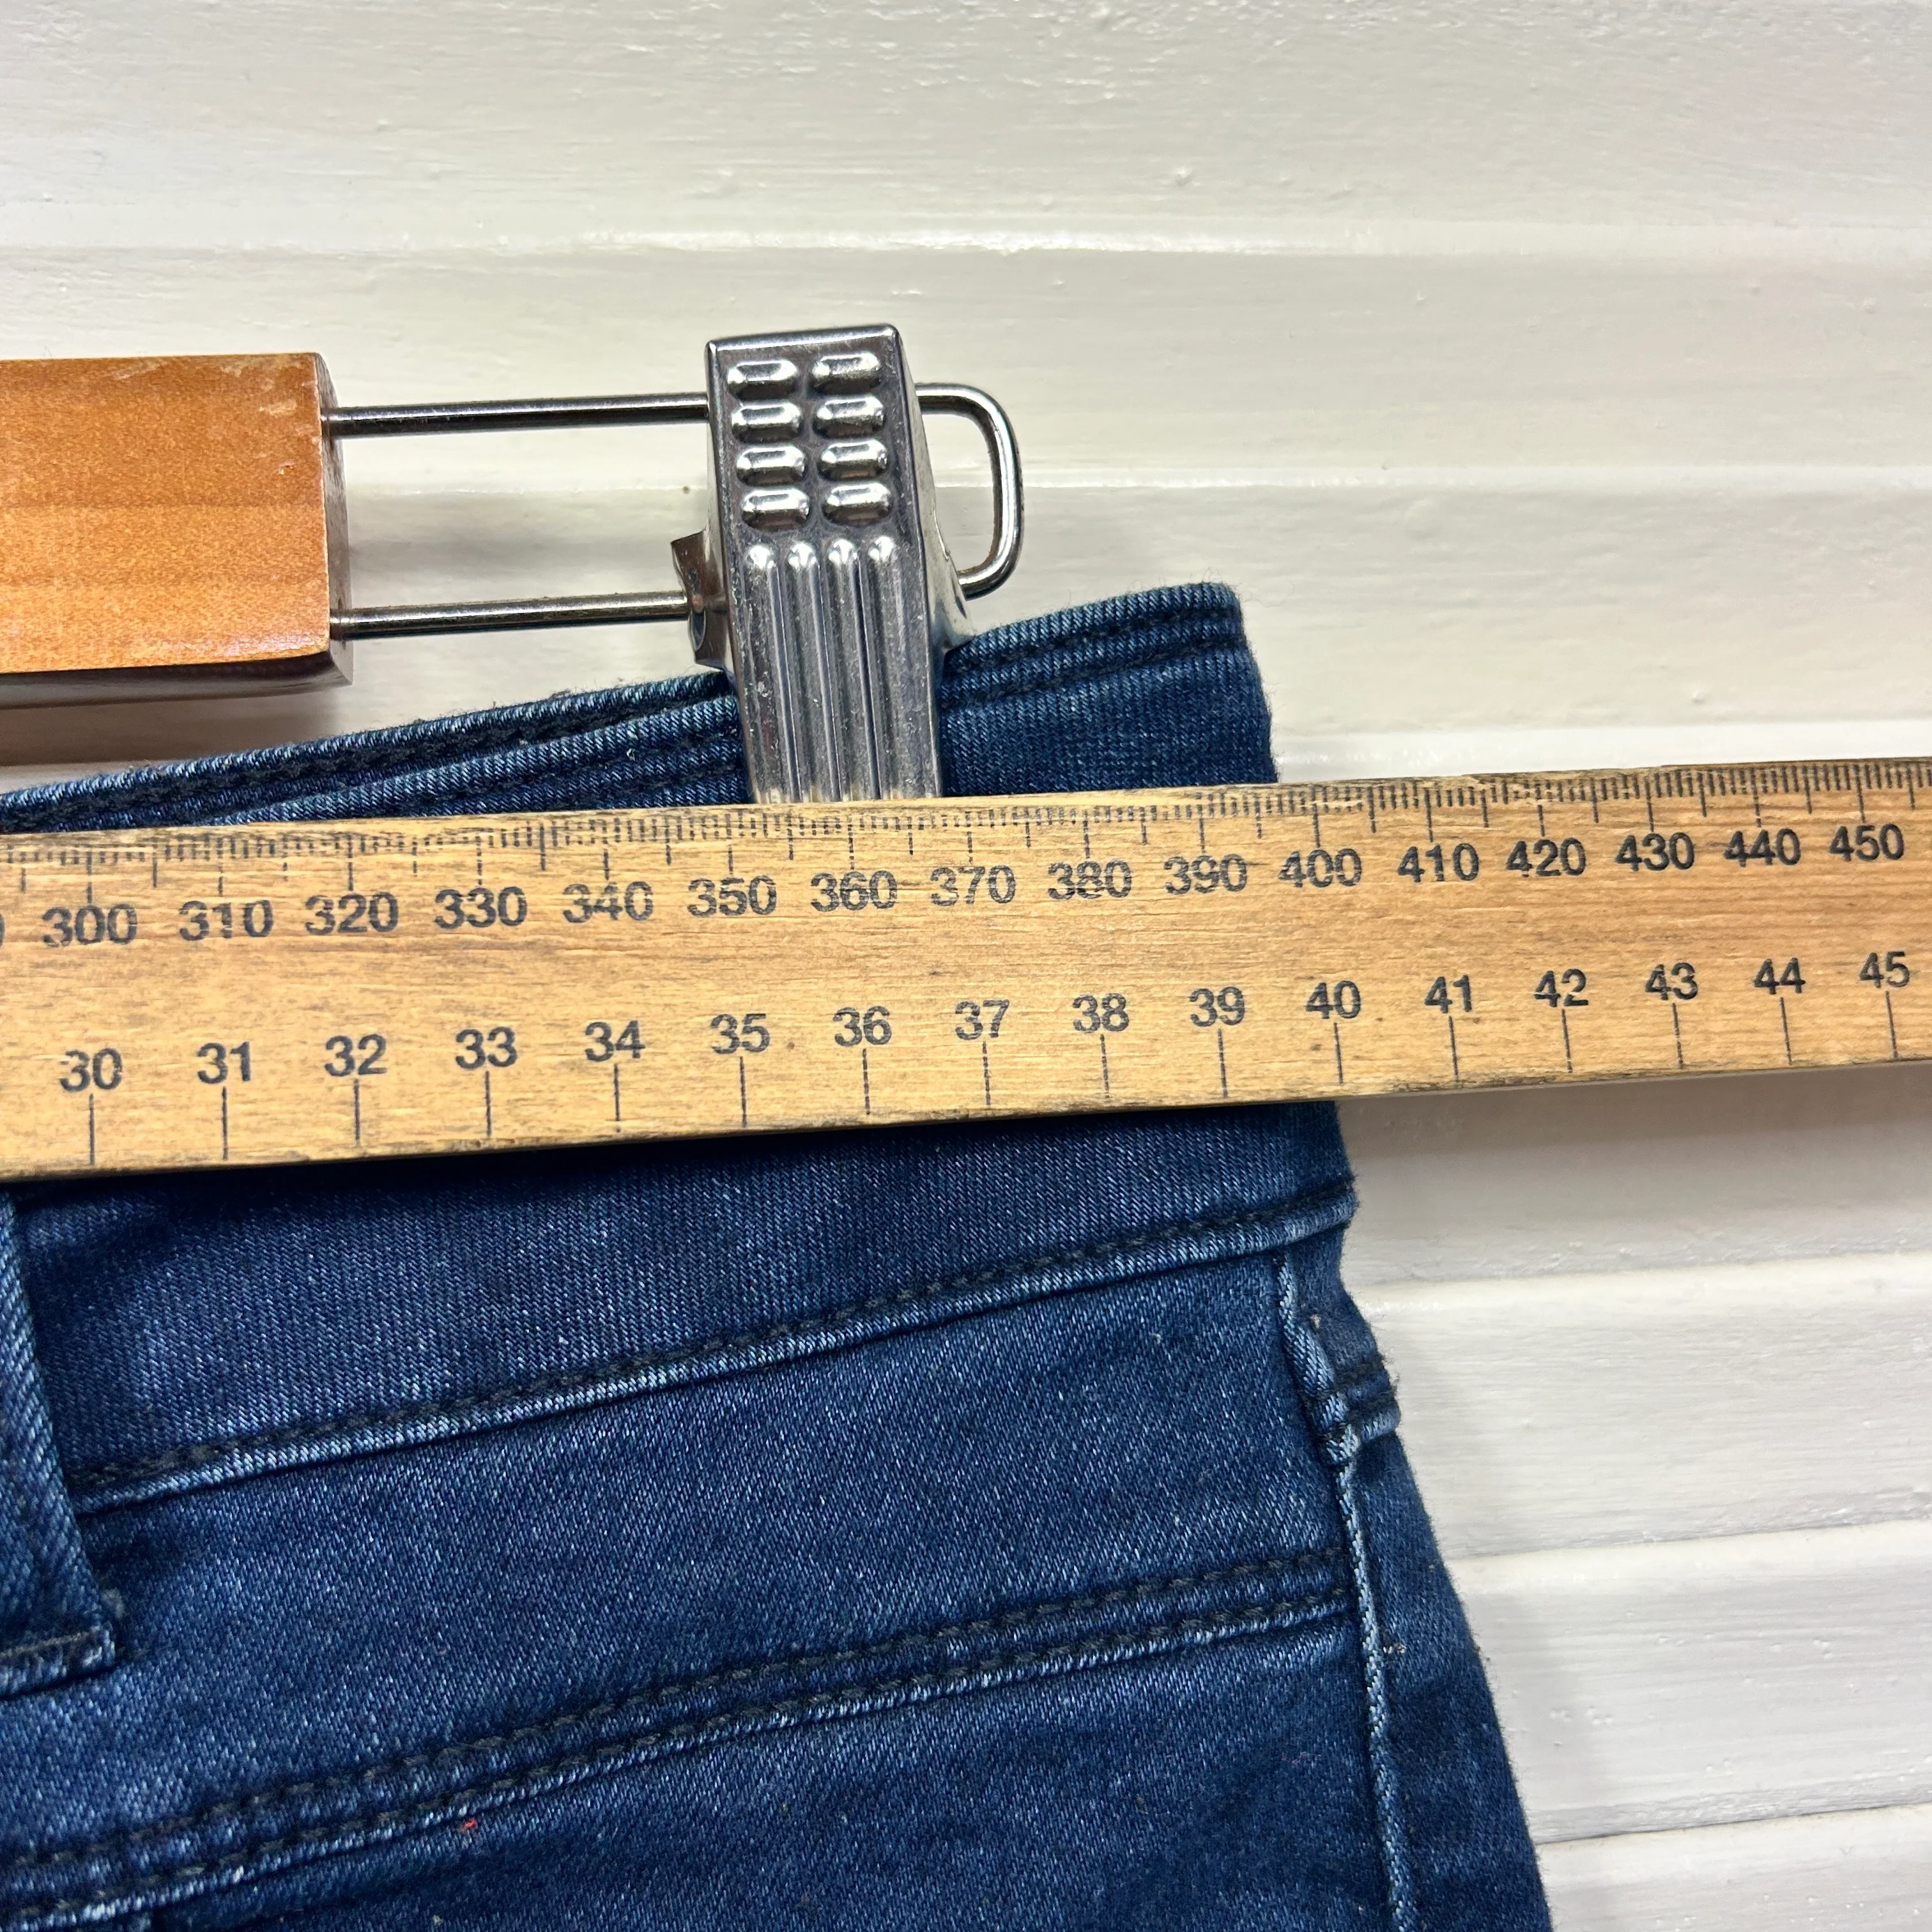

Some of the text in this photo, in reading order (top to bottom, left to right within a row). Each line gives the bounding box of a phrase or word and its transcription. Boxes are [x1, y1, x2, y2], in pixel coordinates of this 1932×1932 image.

[42, 905, 138, 947] 300
[179, 900, 273, 940] 310
[305, 892, 399, 935] 320
[434, 887, 528, 929] 330
[562, 881, 654, 923] 340
[687, 875, 777, 917] 350
[810, 870, 897, 912] 360
[930, 865, 1016, 907] 370
[1048, 860, 1132, 900] 380
[1164, 854, 1247, 894] 390
[1280, 848, 1362, 887] 400
[1396, 843, 1481, 883] 410
[1505, 838, 1586, 877] 420
[1615, 832, 1694, 872] 430
[1724, 828, 1801, 868] 440
[1829, 823, 1904, 861] 450
[59, 951, 1912, 1092] 30 31 32 33 34 35 36 37 38 39 40 41 42 43 44 45
